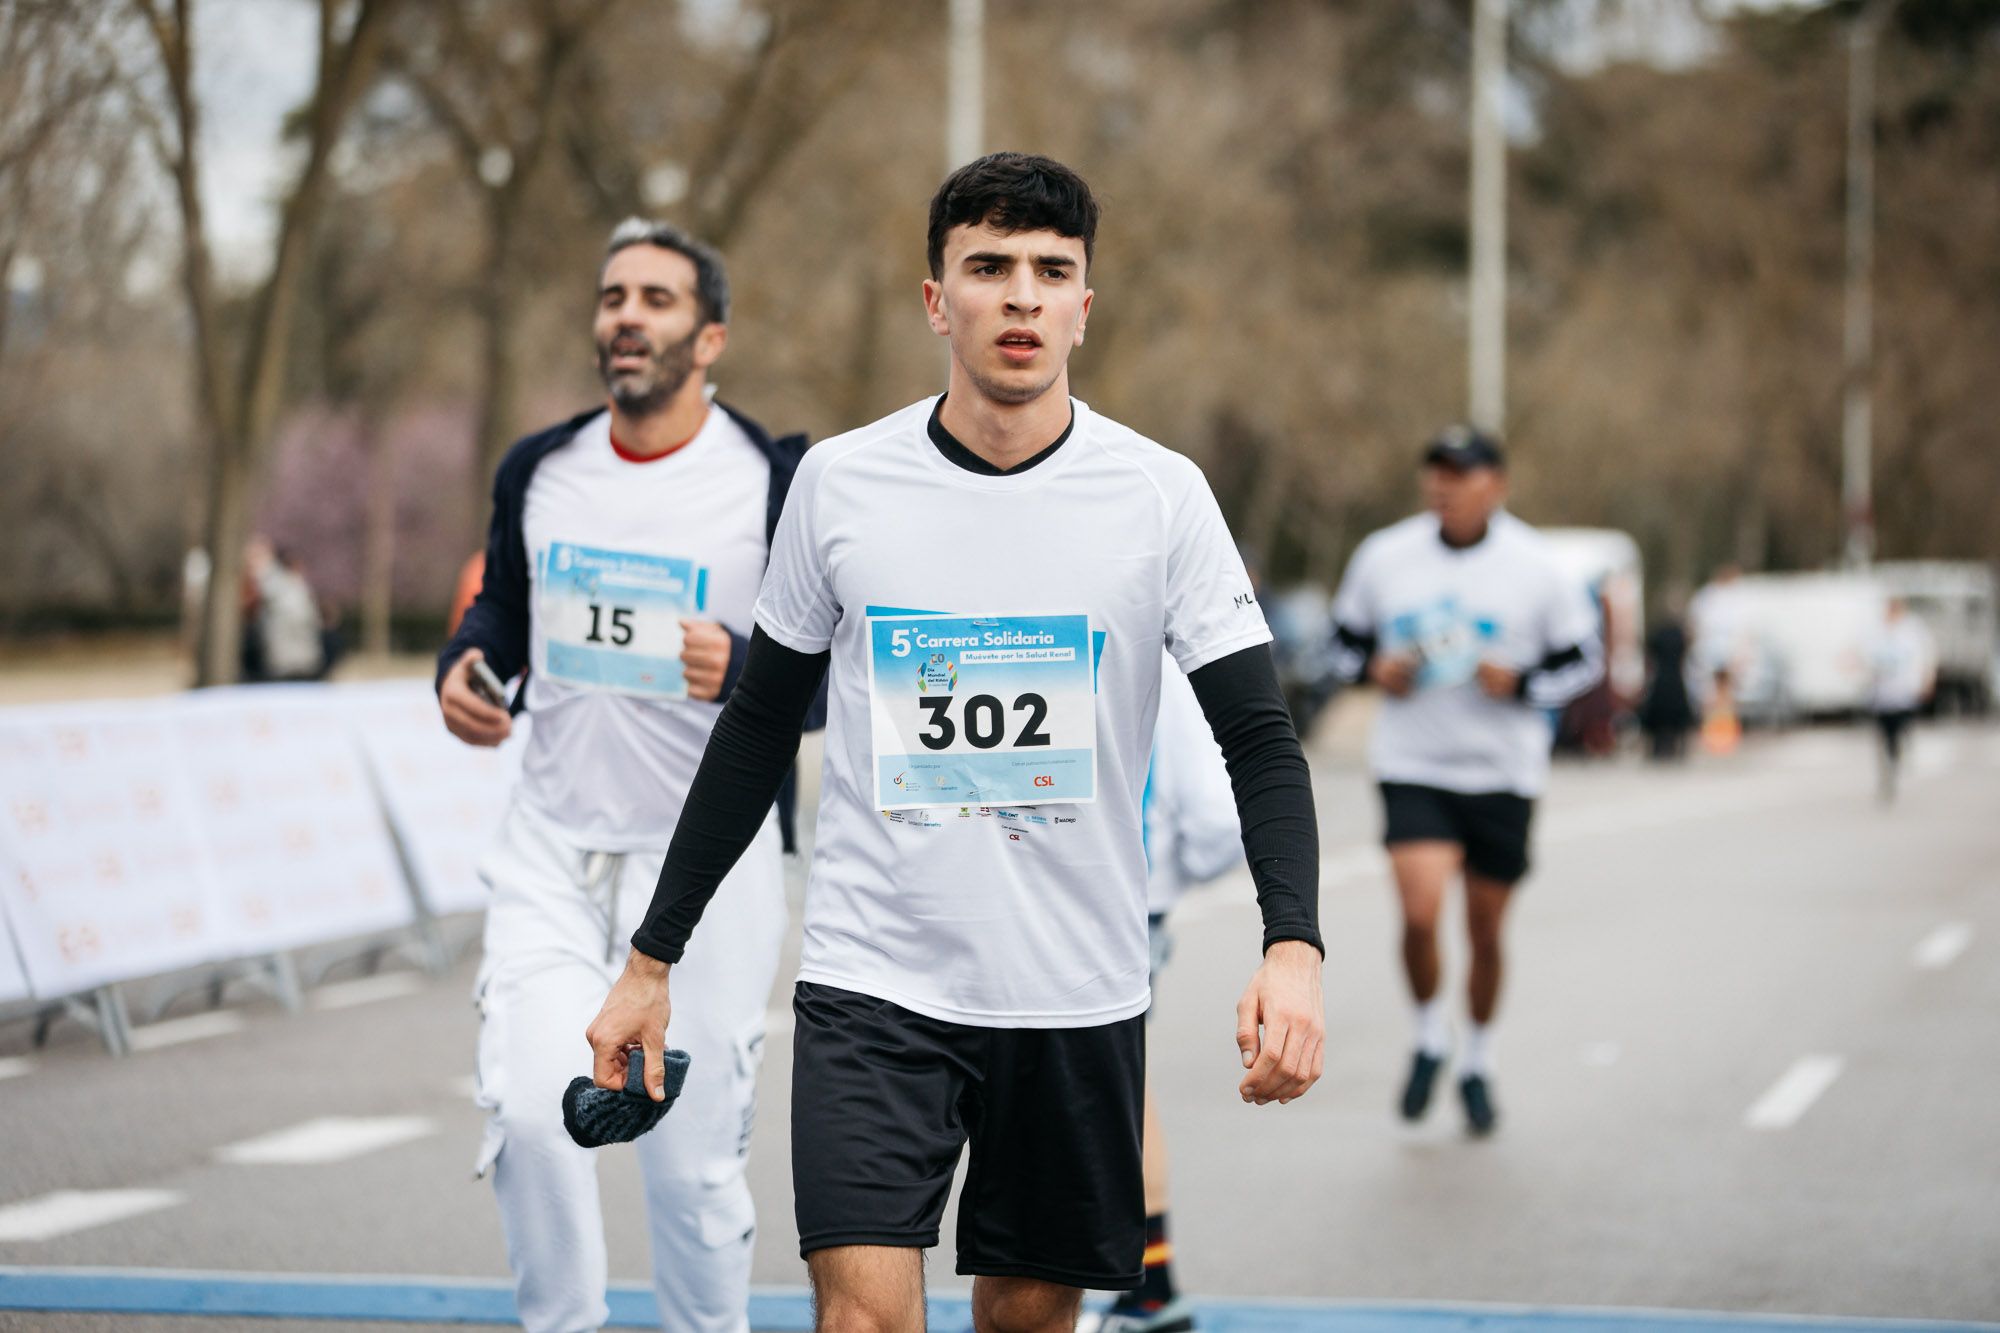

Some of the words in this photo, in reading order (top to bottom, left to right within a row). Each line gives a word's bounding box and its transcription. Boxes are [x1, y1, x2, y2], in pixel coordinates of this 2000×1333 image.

[585, 604, 634, 646] 15
[916, 633, 979, 648] Carrera
[983, 630, 1055, 646] Solidaria
[965, 652, 999, 660] Muévete
[1001, 653, 1014, 662] por
[1025, 651, 1048, 659] Salud
[1049, 650, 1072, 658] Renal
[919, 693, 1050, 750] 302
[1034, 775, 1055, 787] CSL
